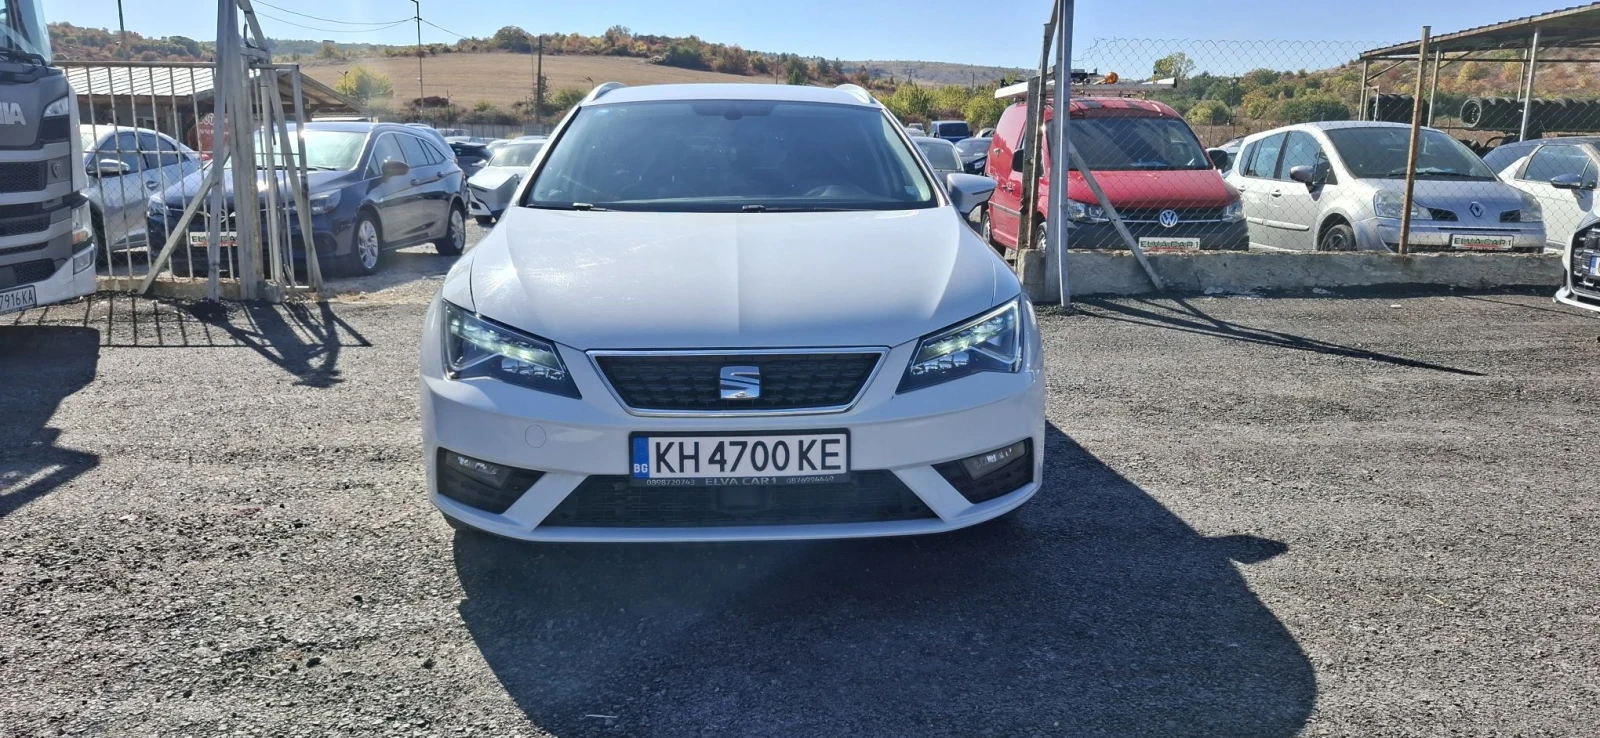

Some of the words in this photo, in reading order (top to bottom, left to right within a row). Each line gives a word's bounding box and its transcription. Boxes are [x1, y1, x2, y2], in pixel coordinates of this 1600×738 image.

[655, 441, 700, 474] KH
[708, 440, 790, 473] 4700
[798, 438, 842, 471] KE
[633, 463, 648, 474] BG
[705, 477, 739, 486] ELVA
